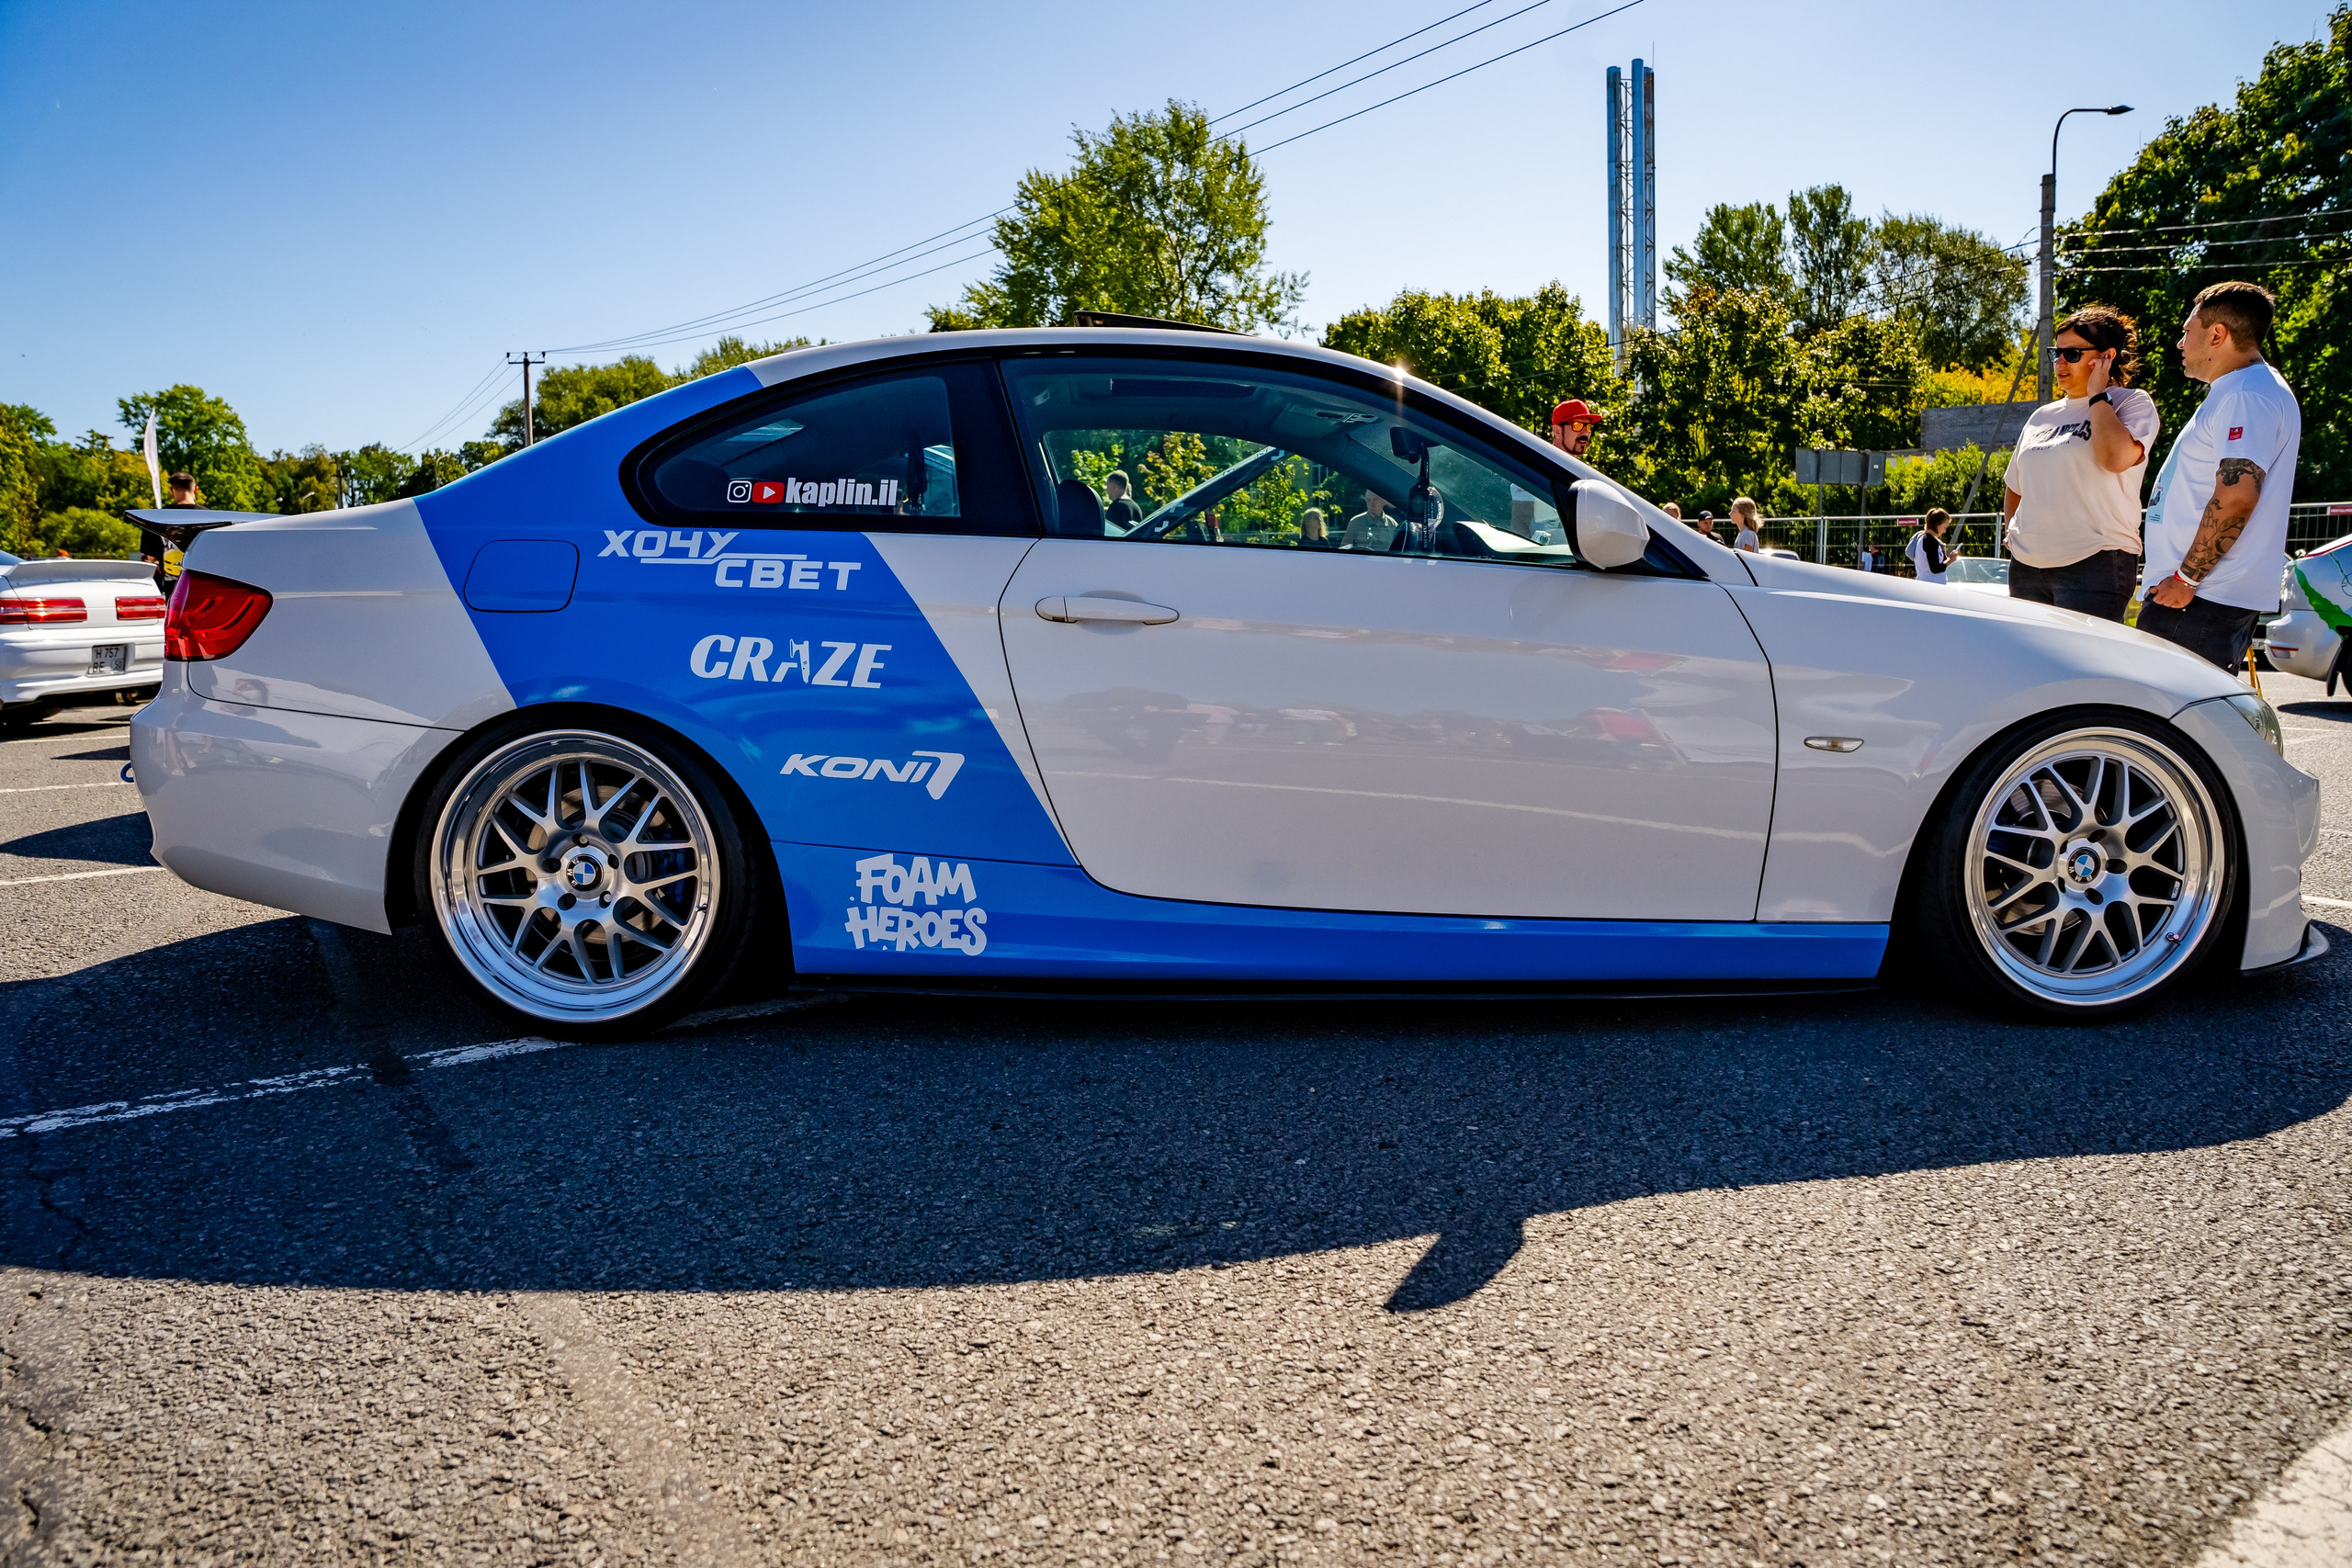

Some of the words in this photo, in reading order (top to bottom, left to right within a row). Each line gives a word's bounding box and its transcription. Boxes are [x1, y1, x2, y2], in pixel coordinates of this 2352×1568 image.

[786, 478, 898, 507] kaplin.il
[598, 530, 740, 558] ХОЧУ
[715, 559, 861, 591] СВЕТ
[105, 648, 119, 658] 757
[690, 634, 892, 689] CRAZE
[856, 853, 977, 906] FOAM
[844, 906, 988, 956] HEROES
